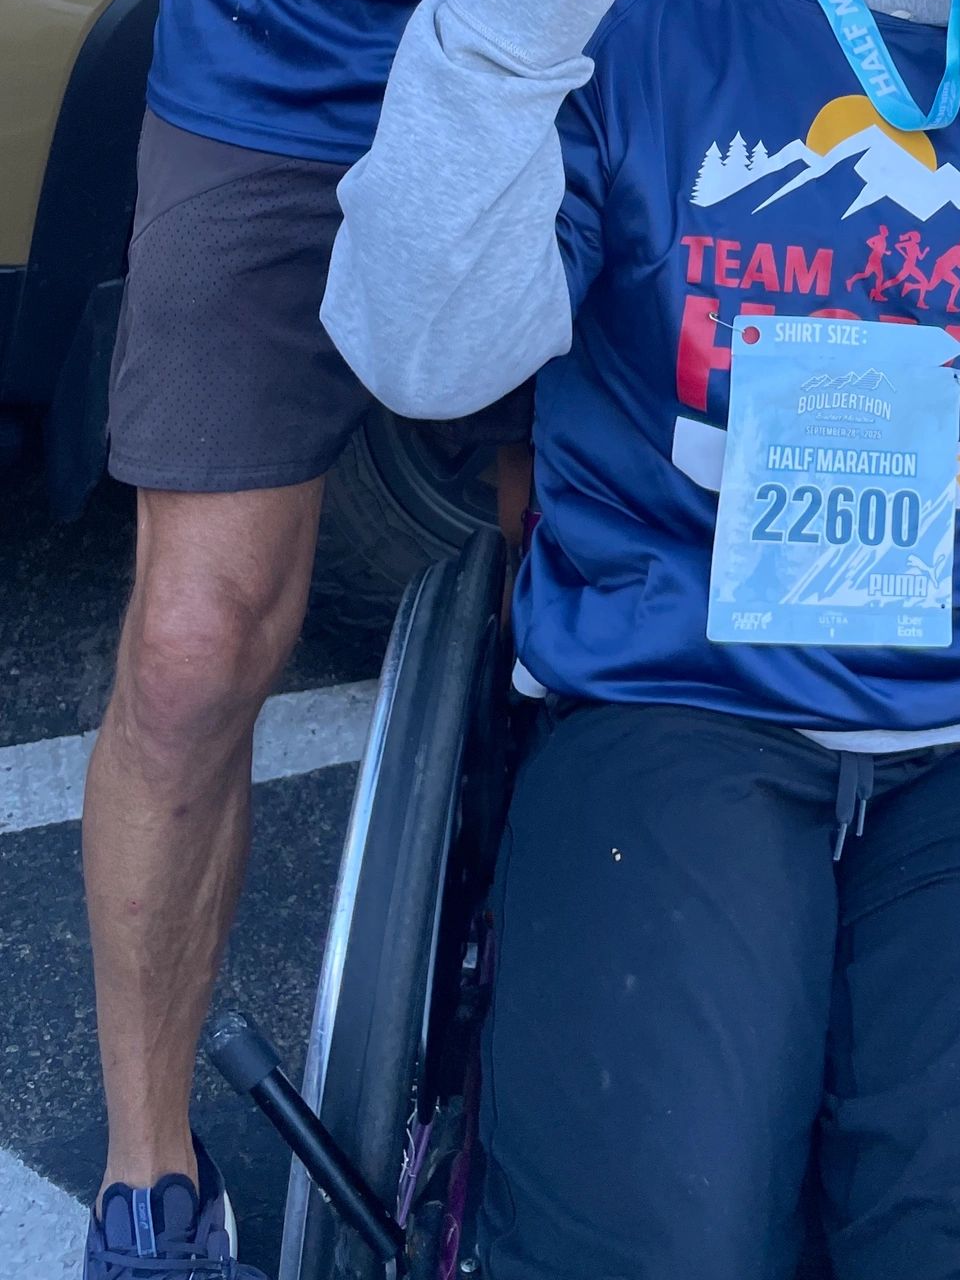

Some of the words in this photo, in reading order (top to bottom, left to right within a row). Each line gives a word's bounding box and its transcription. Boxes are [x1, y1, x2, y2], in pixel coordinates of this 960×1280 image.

[844, 25, 897, 98] HALF
[680, 236, 834, 296] TEAM
[774, 322, 823, 343] SHIRT
[827, 324, 868, 346] SIZE:
[797, 392, 892, 420] BOULDERTHON
[805, 425, 847, 437] SEPTEMBER
[767, 445, 812, 472] HALF
[816, 447, 918, 477] MARATHON
[751, 482, 920, 548] 22600
[868, 573, 928, 597] PUMA
[897, 613, 922, 626] Uber
[897, 625, 923, 637] Eats
